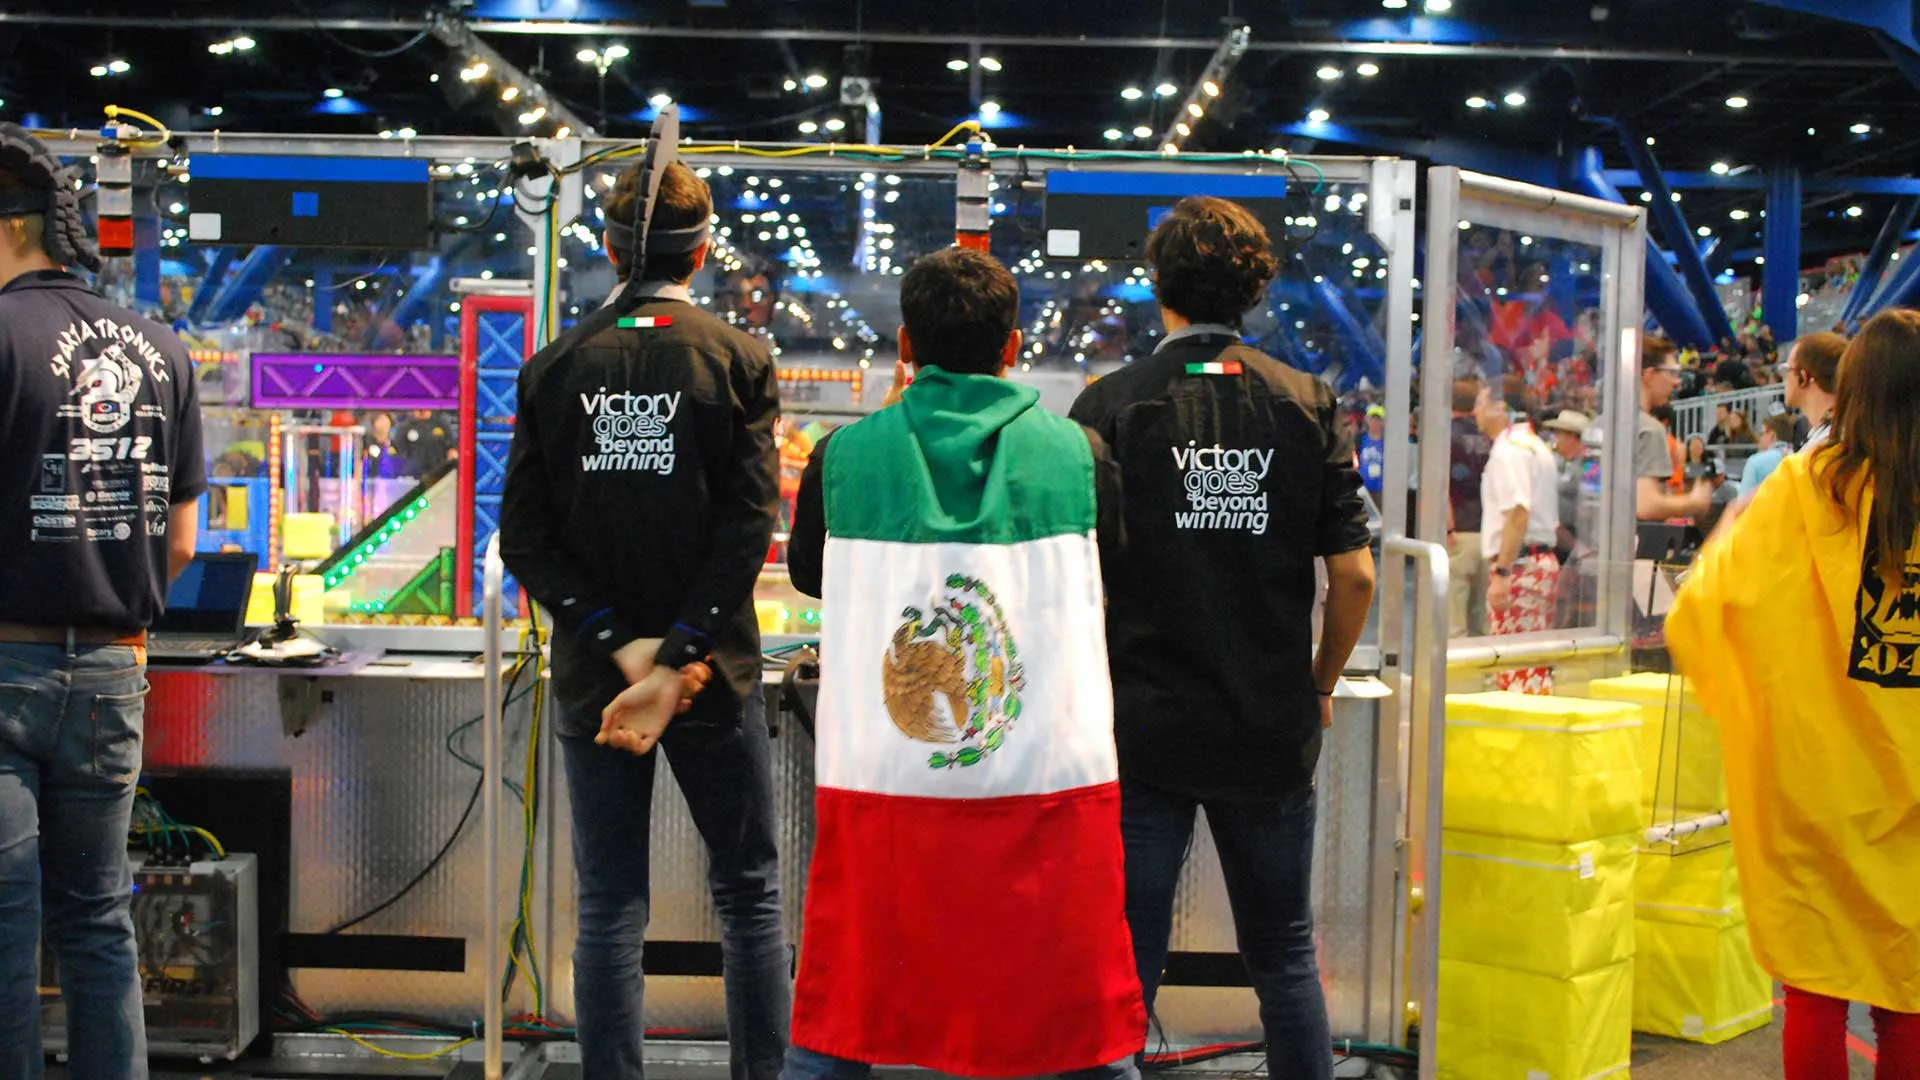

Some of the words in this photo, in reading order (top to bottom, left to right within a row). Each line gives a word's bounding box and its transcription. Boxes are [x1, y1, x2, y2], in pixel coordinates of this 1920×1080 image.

[580, 386, 681, 423] victory
[593, 414, 667, 444] goes
[69, 436, 152, 461] 3512
[600, 433, 674, 455] beyond
[581, 452, 675, 475] winning
[1171, 440, 1274, 480] victory
[1184, 469, 1259, 501] goes
[1192, 491, 1267, 512] beyond
[1174, 511, 1269, 535] winning
